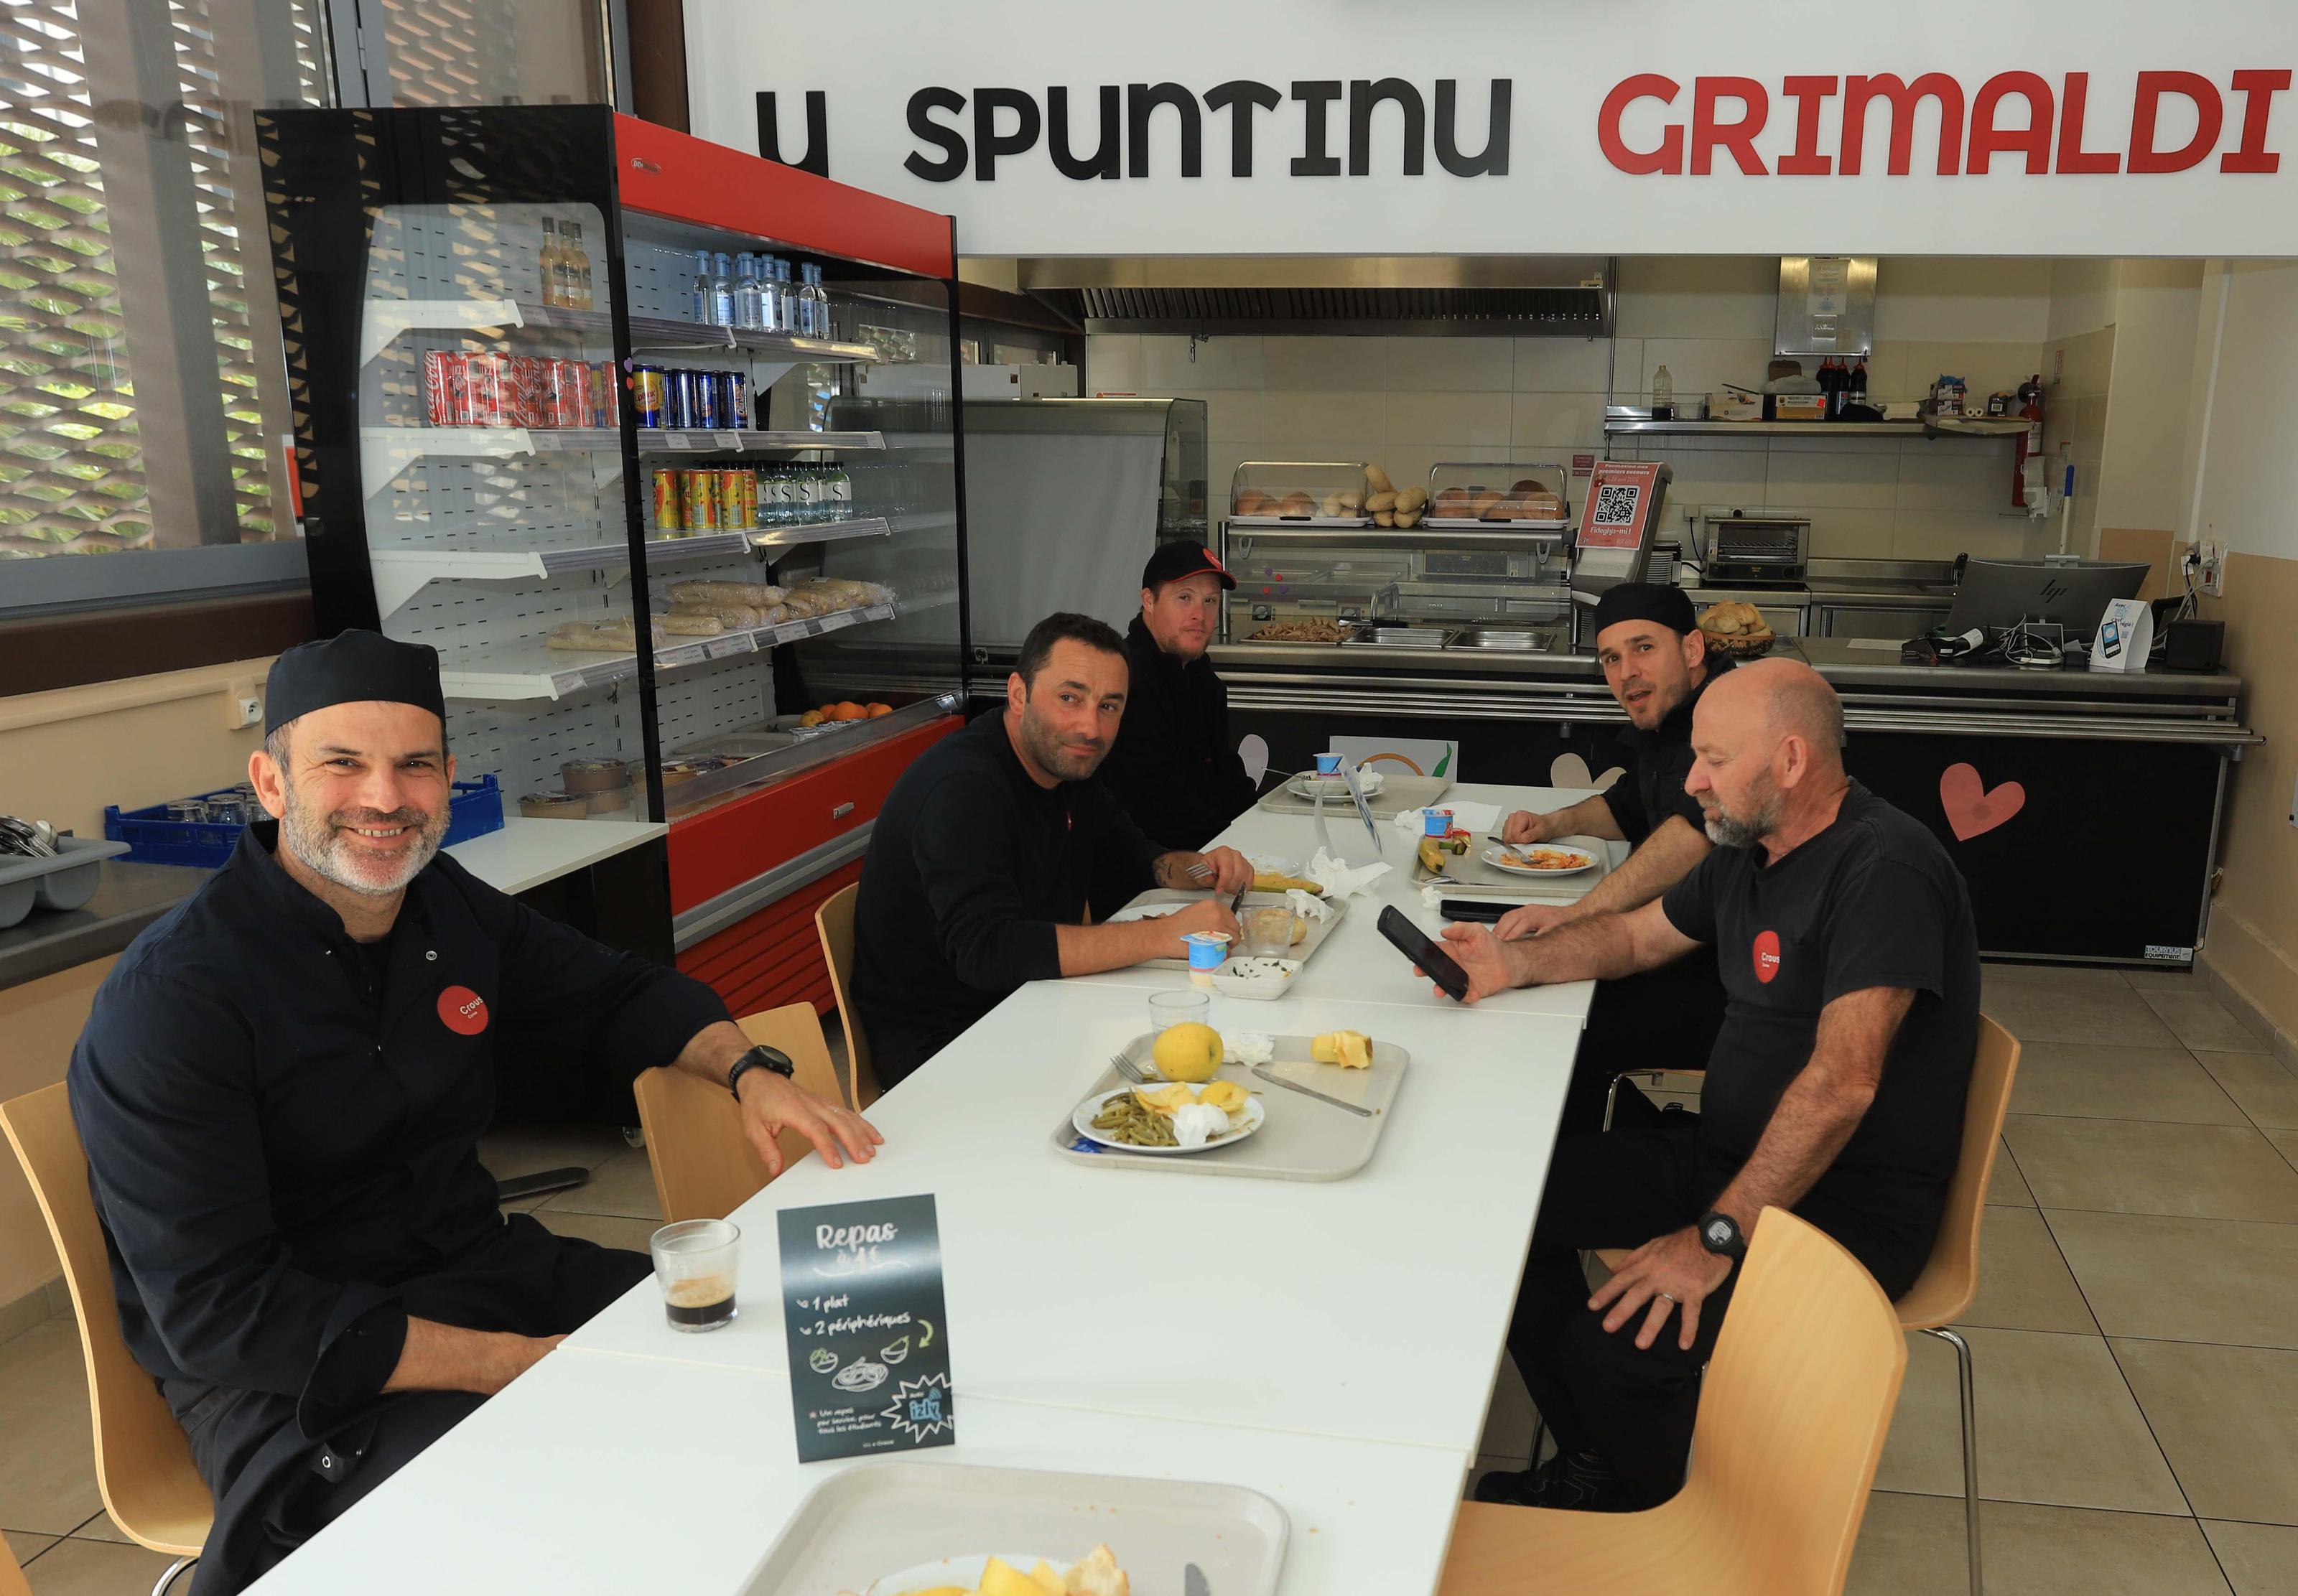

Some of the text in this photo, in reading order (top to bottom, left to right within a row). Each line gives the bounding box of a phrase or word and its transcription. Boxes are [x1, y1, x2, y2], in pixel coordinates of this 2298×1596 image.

[755, 90, 829, 179] U
[1599, 70, 2292, 175] GRIMALDI
[460, 997, 483, 1014] Crous
[816, 1222, 898, 1252] Repas
[812, 1293, 850, 1314] 1 plat
[814, 1311, 911, 1337] 2 périphériques
